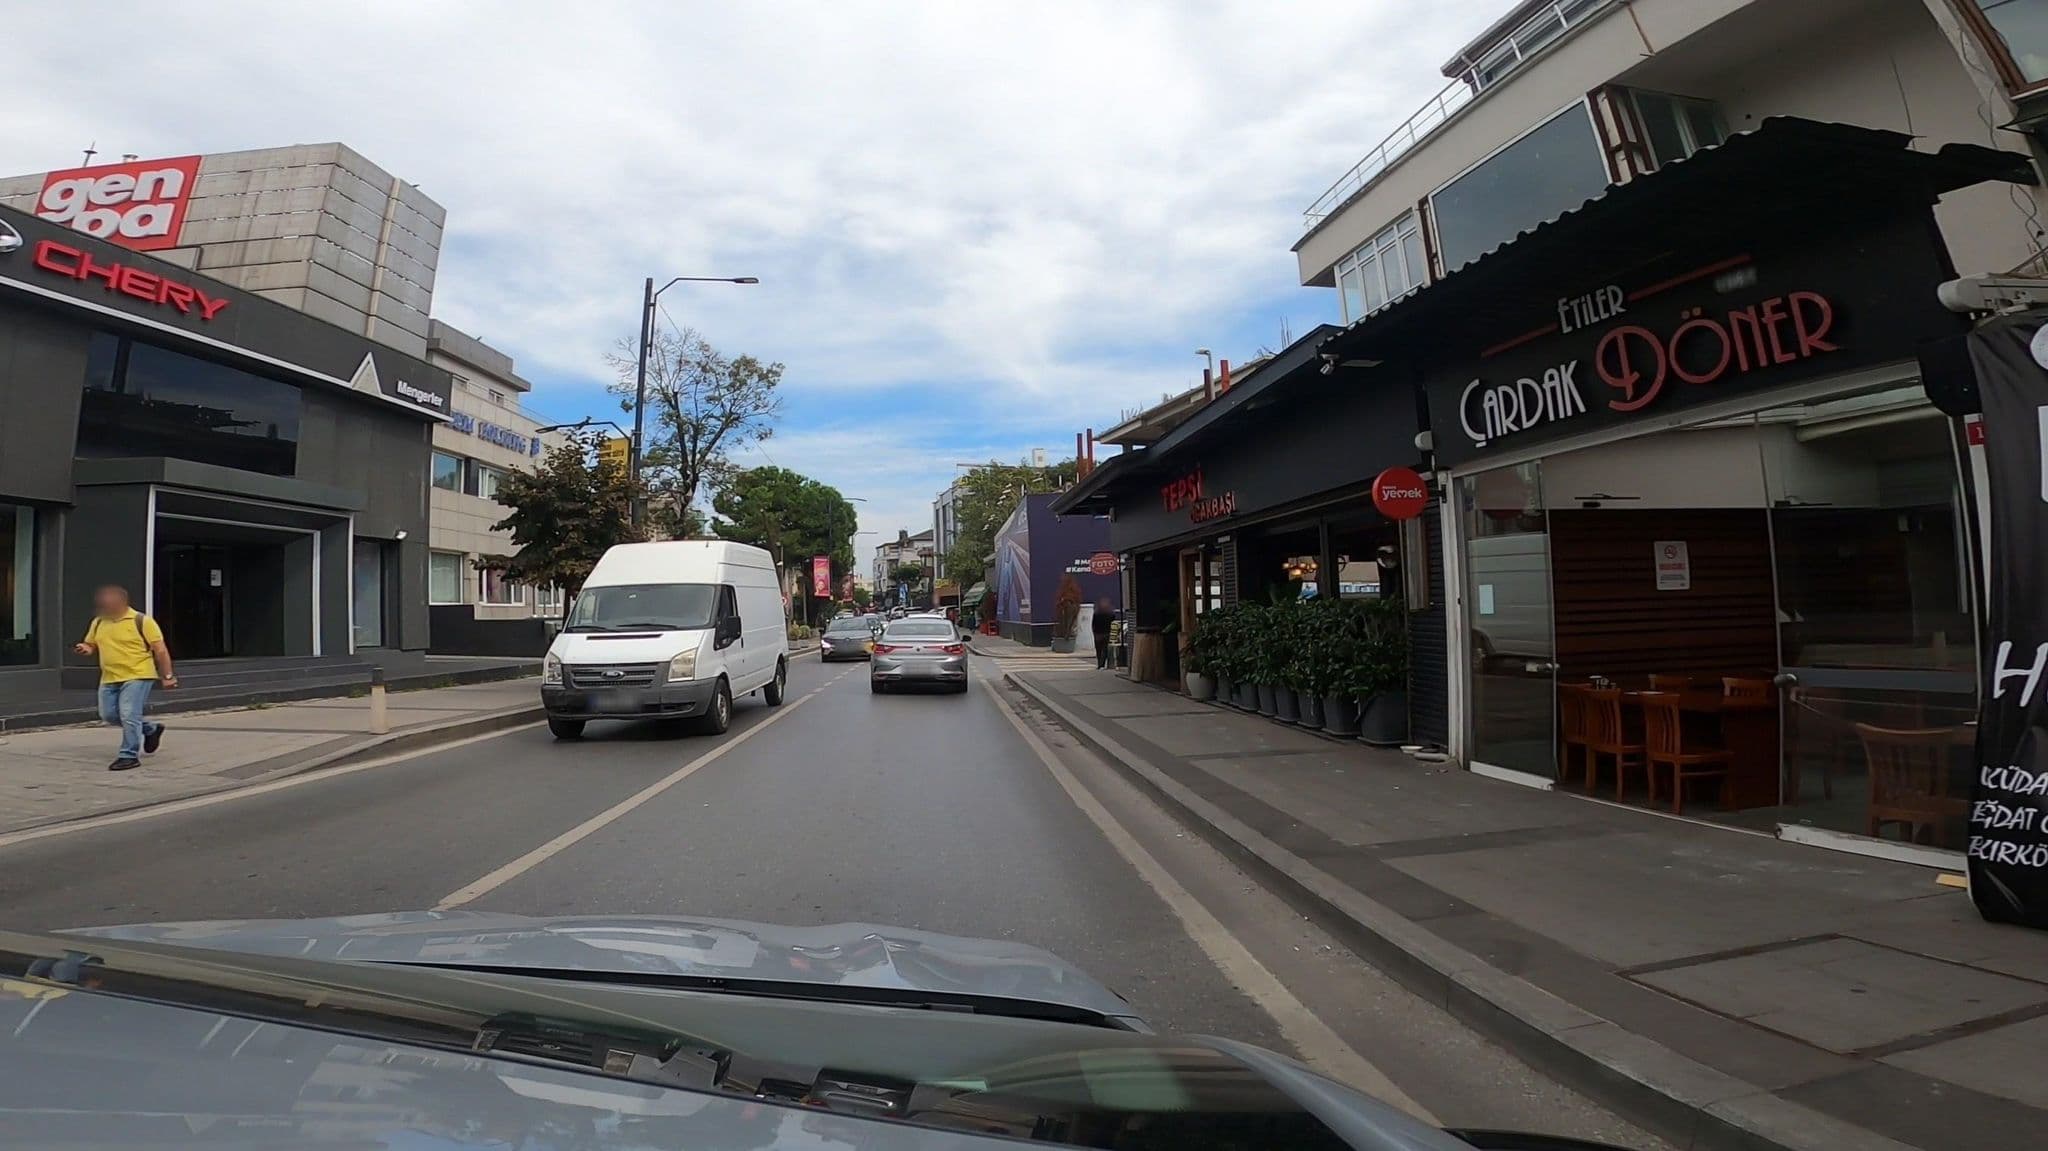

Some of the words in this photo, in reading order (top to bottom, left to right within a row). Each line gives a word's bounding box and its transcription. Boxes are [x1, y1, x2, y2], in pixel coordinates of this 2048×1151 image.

[38, 168, 184, 223] gen
[34, 240, 229, 319] CHERY
[1460, 360, 1586, 448] ÇARDAK
[1596, 291, 1840, 411] DÖNER
[1382, 488, 1422, 501] yemek
[1091, 560, 1115, 569] FOTO
